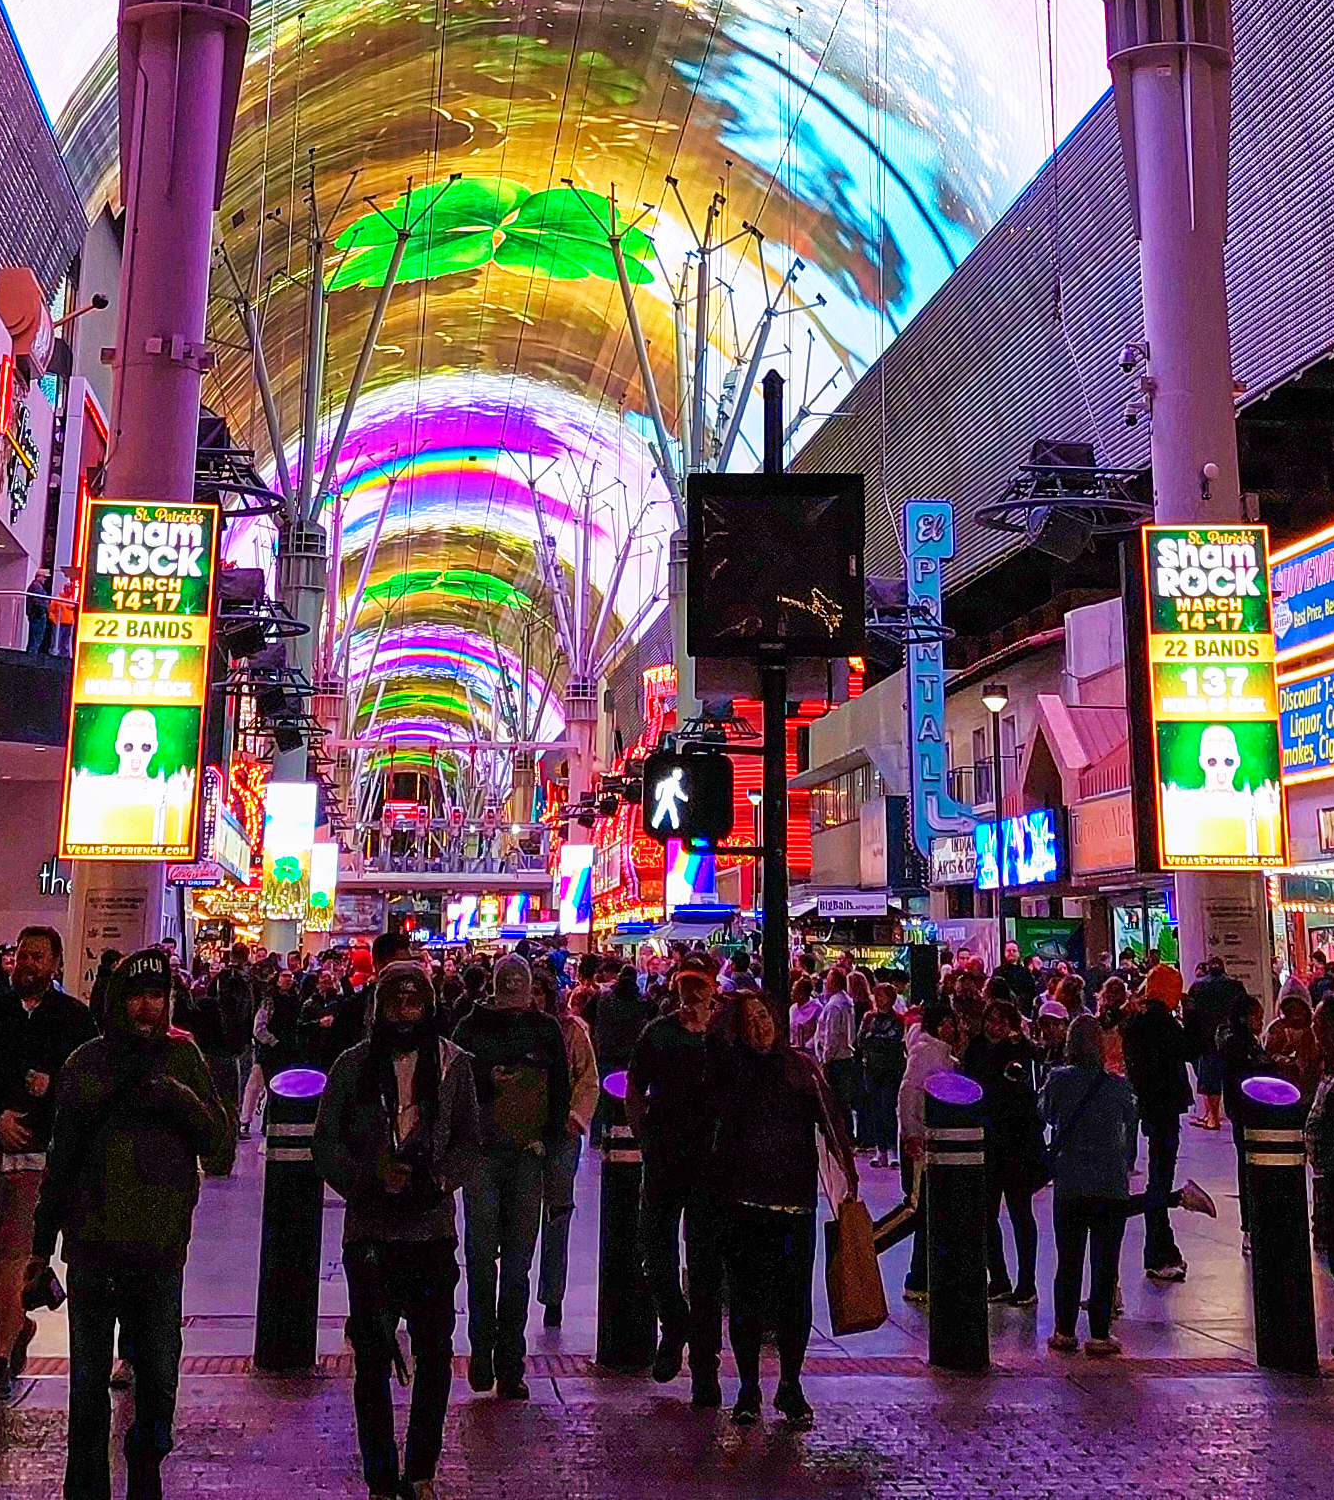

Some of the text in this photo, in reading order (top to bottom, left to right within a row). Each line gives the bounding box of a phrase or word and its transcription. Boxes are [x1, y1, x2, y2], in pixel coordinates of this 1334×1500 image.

[100, 514, 203, 547] Sham
[917, 513, 945, 543] El
[96, 543, 204, 577] ROCK
[1157, 538, 1256, 569] Sham
[112, 577, 182, 592] MARCH
[1156, 566, 1261, 597] ROCK
[112, 591, 181, 612] 14-17
[1175, 597, 1243, 612] MARCH
[94, 619, 193, 639] 22 BANDS
[1176, 612, 1243, 631] 14-17
[1293, 605, 1307, 628] Best
[1164, 639, 1260, 658] 22 BANDS
[107, 648, 180, 680] 137
[1180, 666, 1249, 697] 137
[1279, 680, 1322, 714] Discount
[1290, 713, 1323, 741] Liquor,
[937, 859, 956, 876] ARTS
